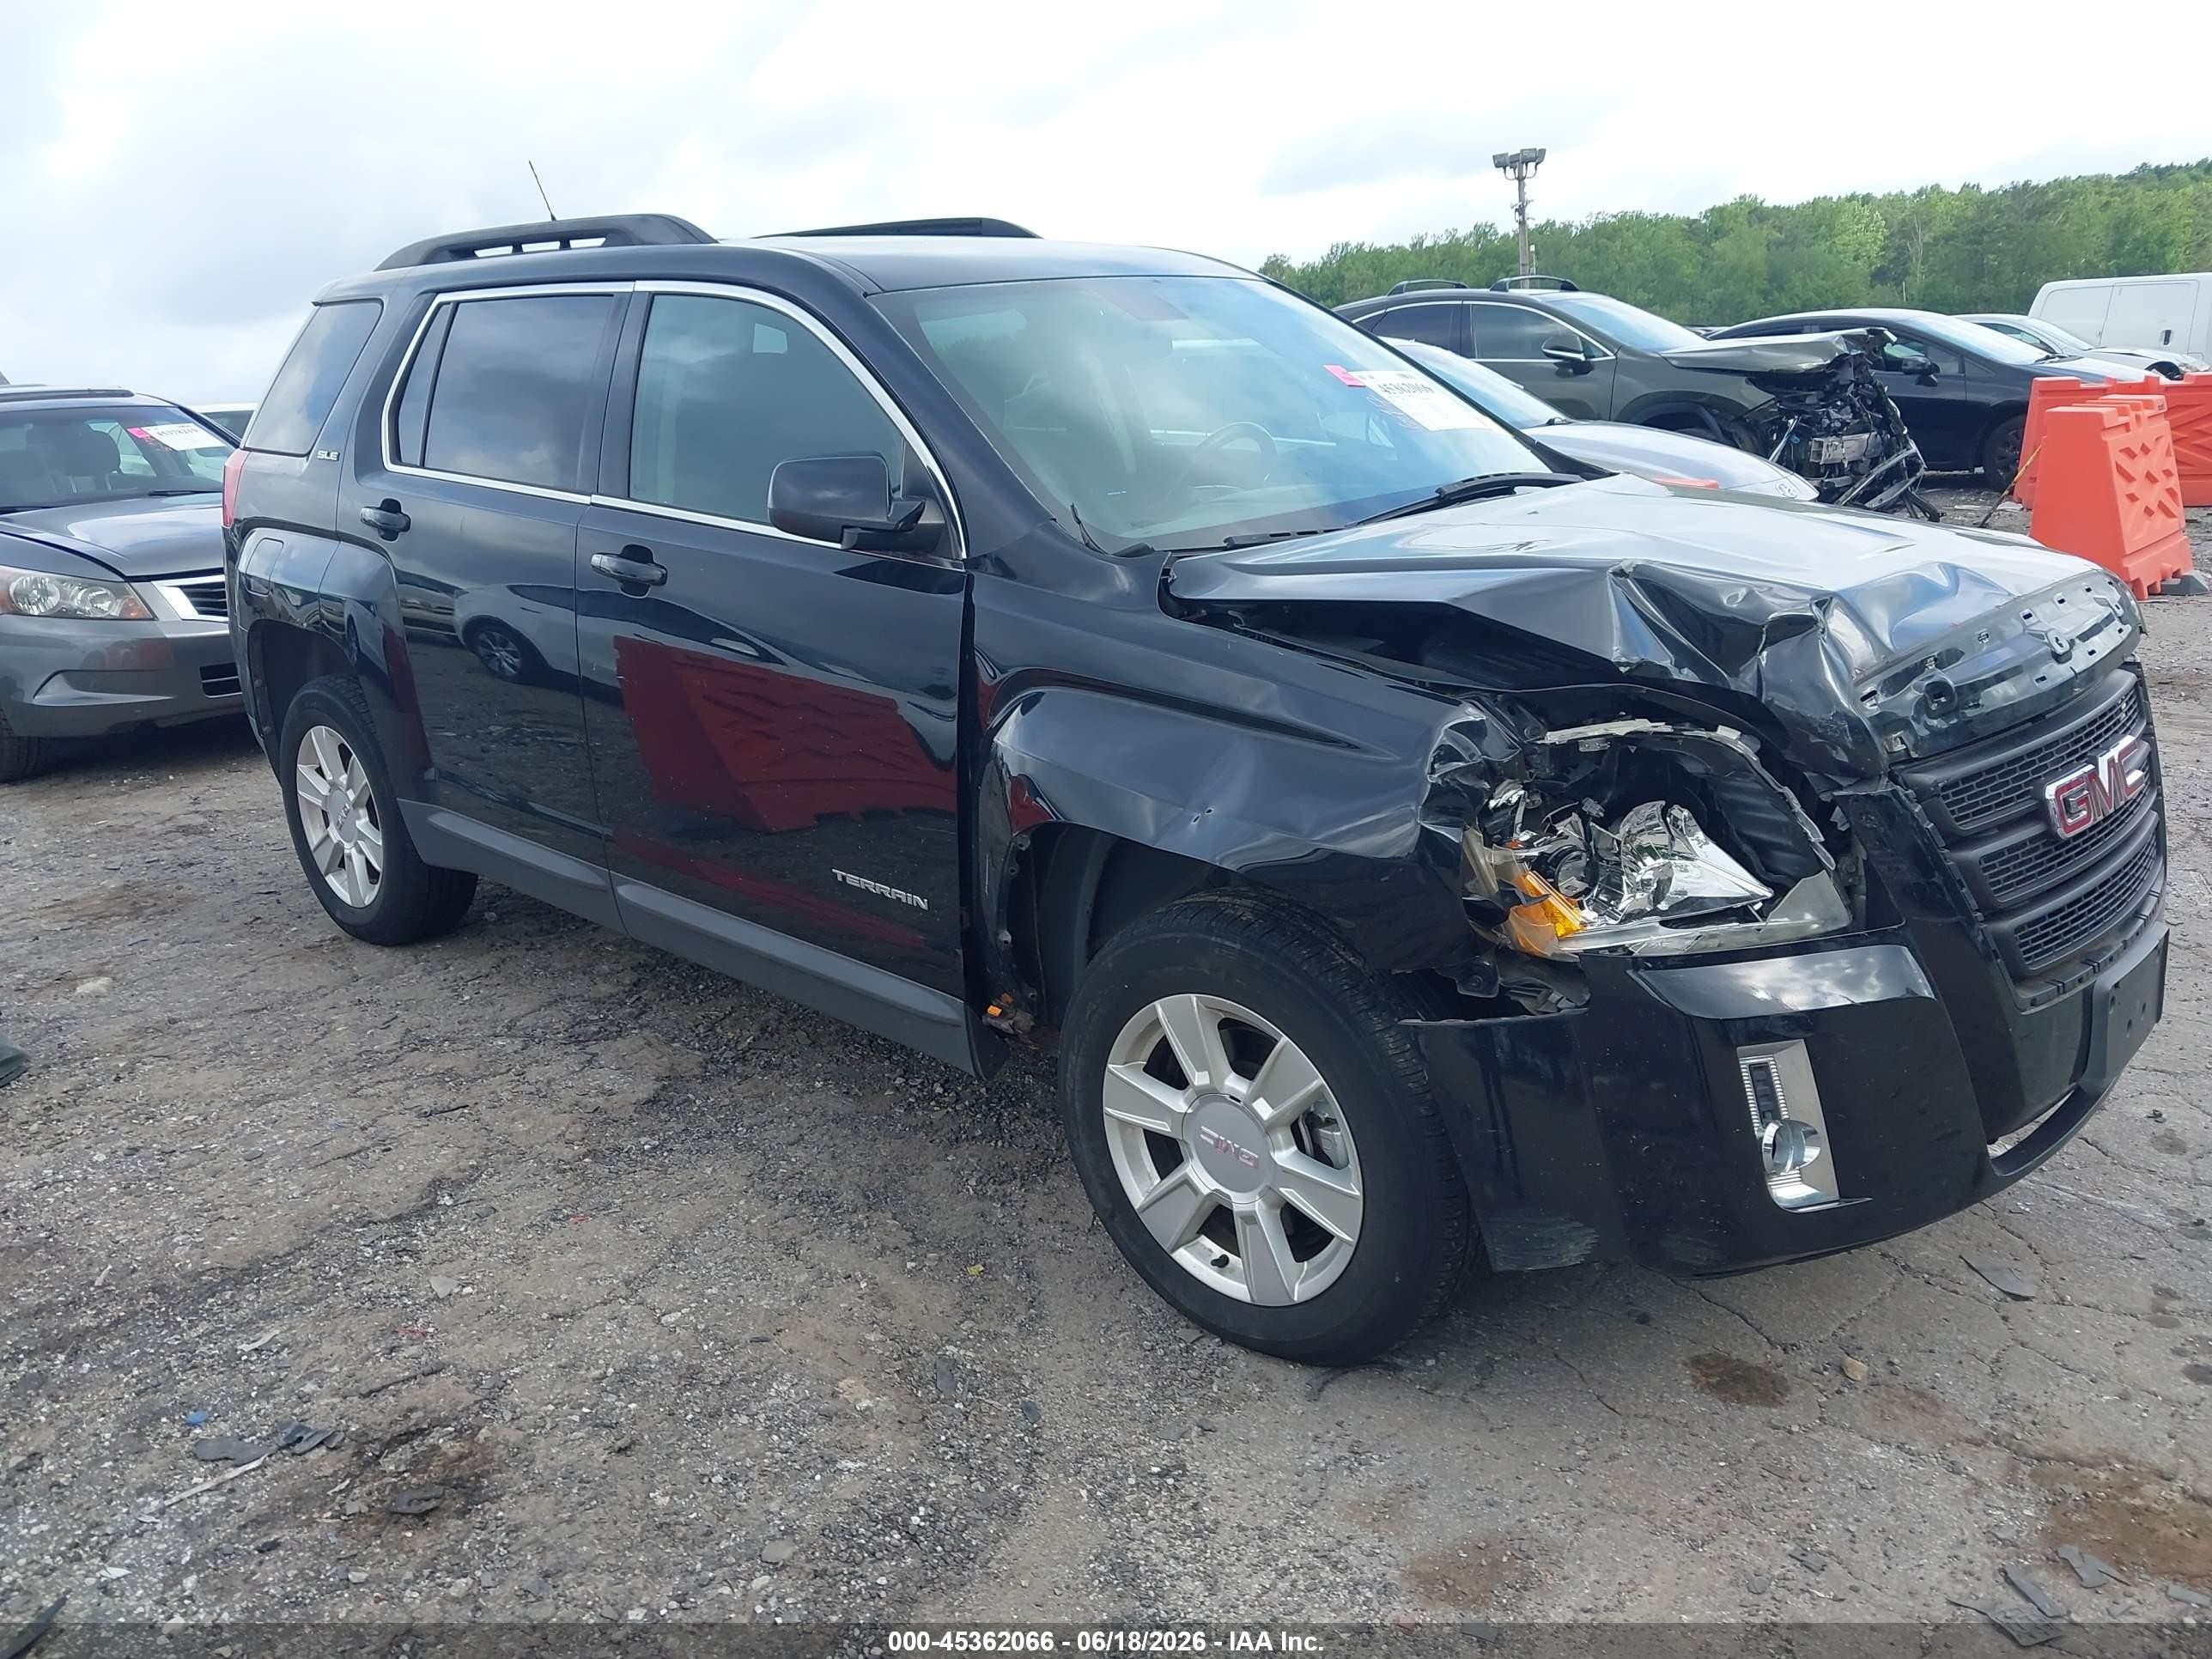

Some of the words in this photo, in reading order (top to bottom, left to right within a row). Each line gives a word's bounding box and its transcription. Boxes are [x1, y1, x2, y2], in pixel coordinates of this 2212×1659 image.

[317, 450, 339, 461] SLE
[2045, 734, 2145, 840] GMC
[831, 868, 928, 910] TERRAIN
